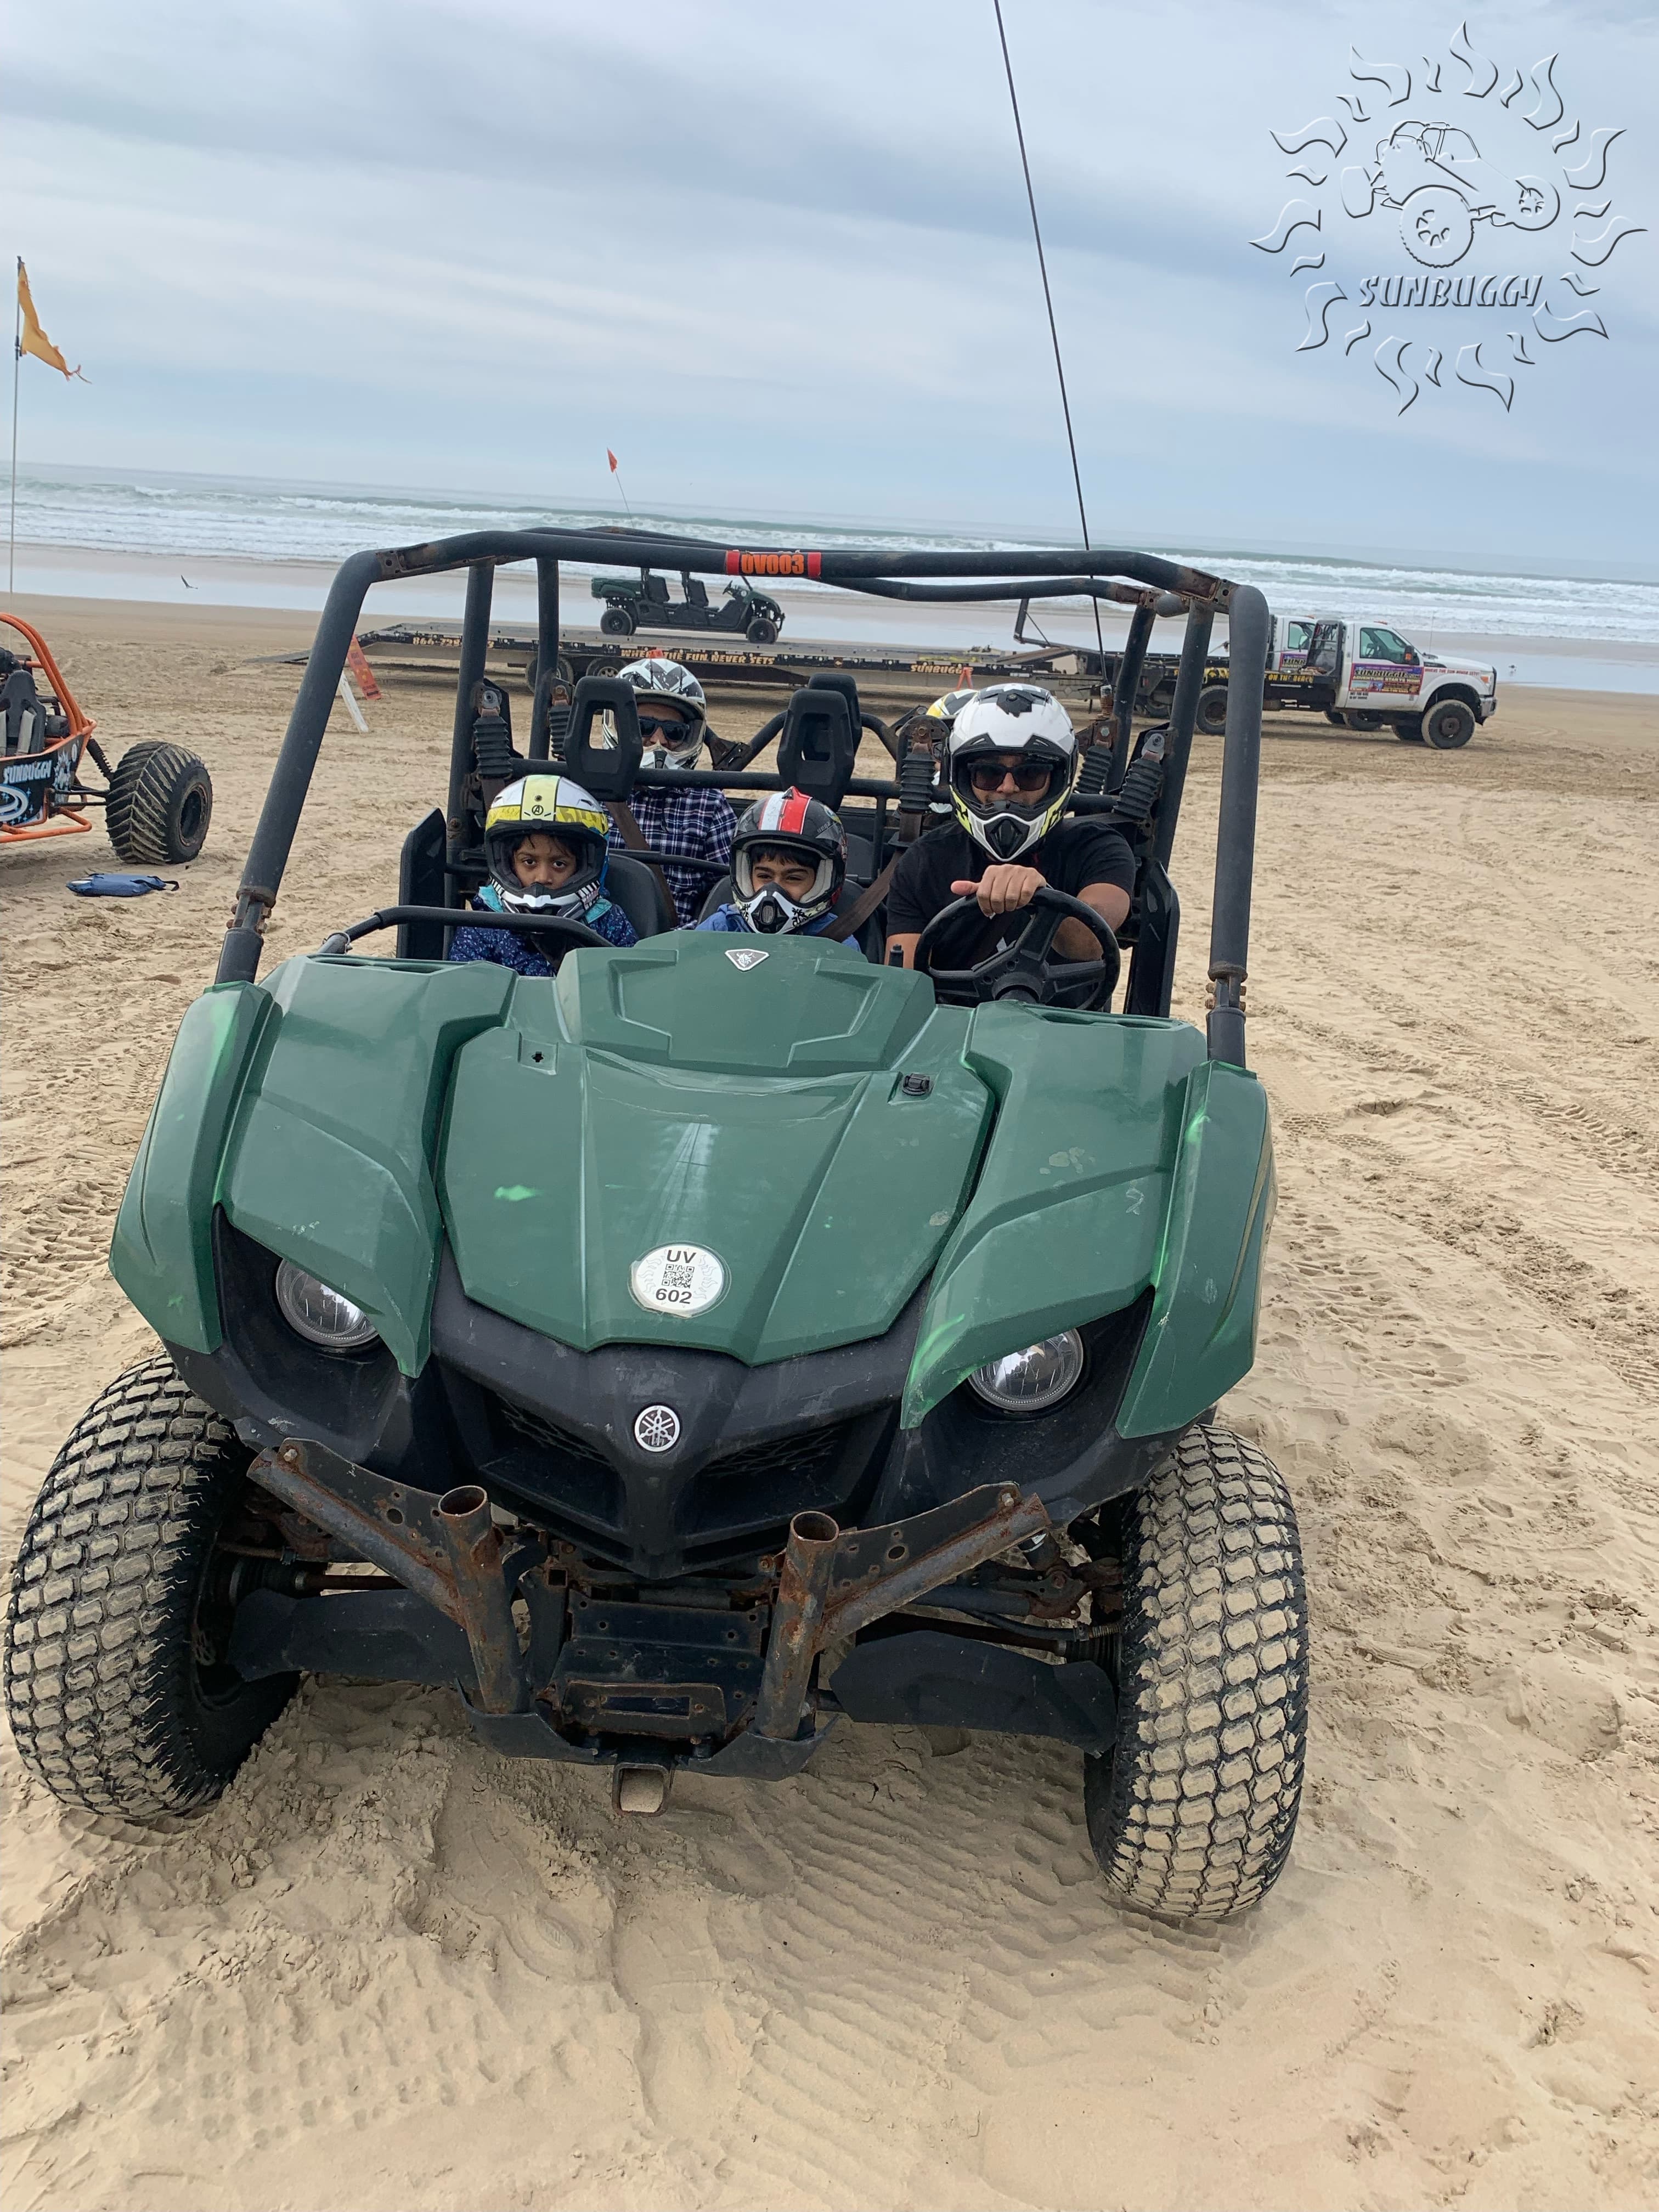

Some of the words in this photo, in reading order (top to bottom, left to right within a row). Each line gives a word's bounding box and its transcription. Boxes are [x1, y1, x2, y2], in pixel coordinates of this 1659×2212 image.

[413, 637, 494, 648] 866-728-3
[621, 649, 659, 658] WHER
[663, 651, 683, 659] THE
[686, 653, 707, 661] FUN
[711, 654, 747, 663] NEVER
[749, 656, 775, 664] SETS
[911, 664, 974, 675] SUNBUGGE
[667, 1249, 697, 1263] UV
[656, 1288, 692, 1304] 602
